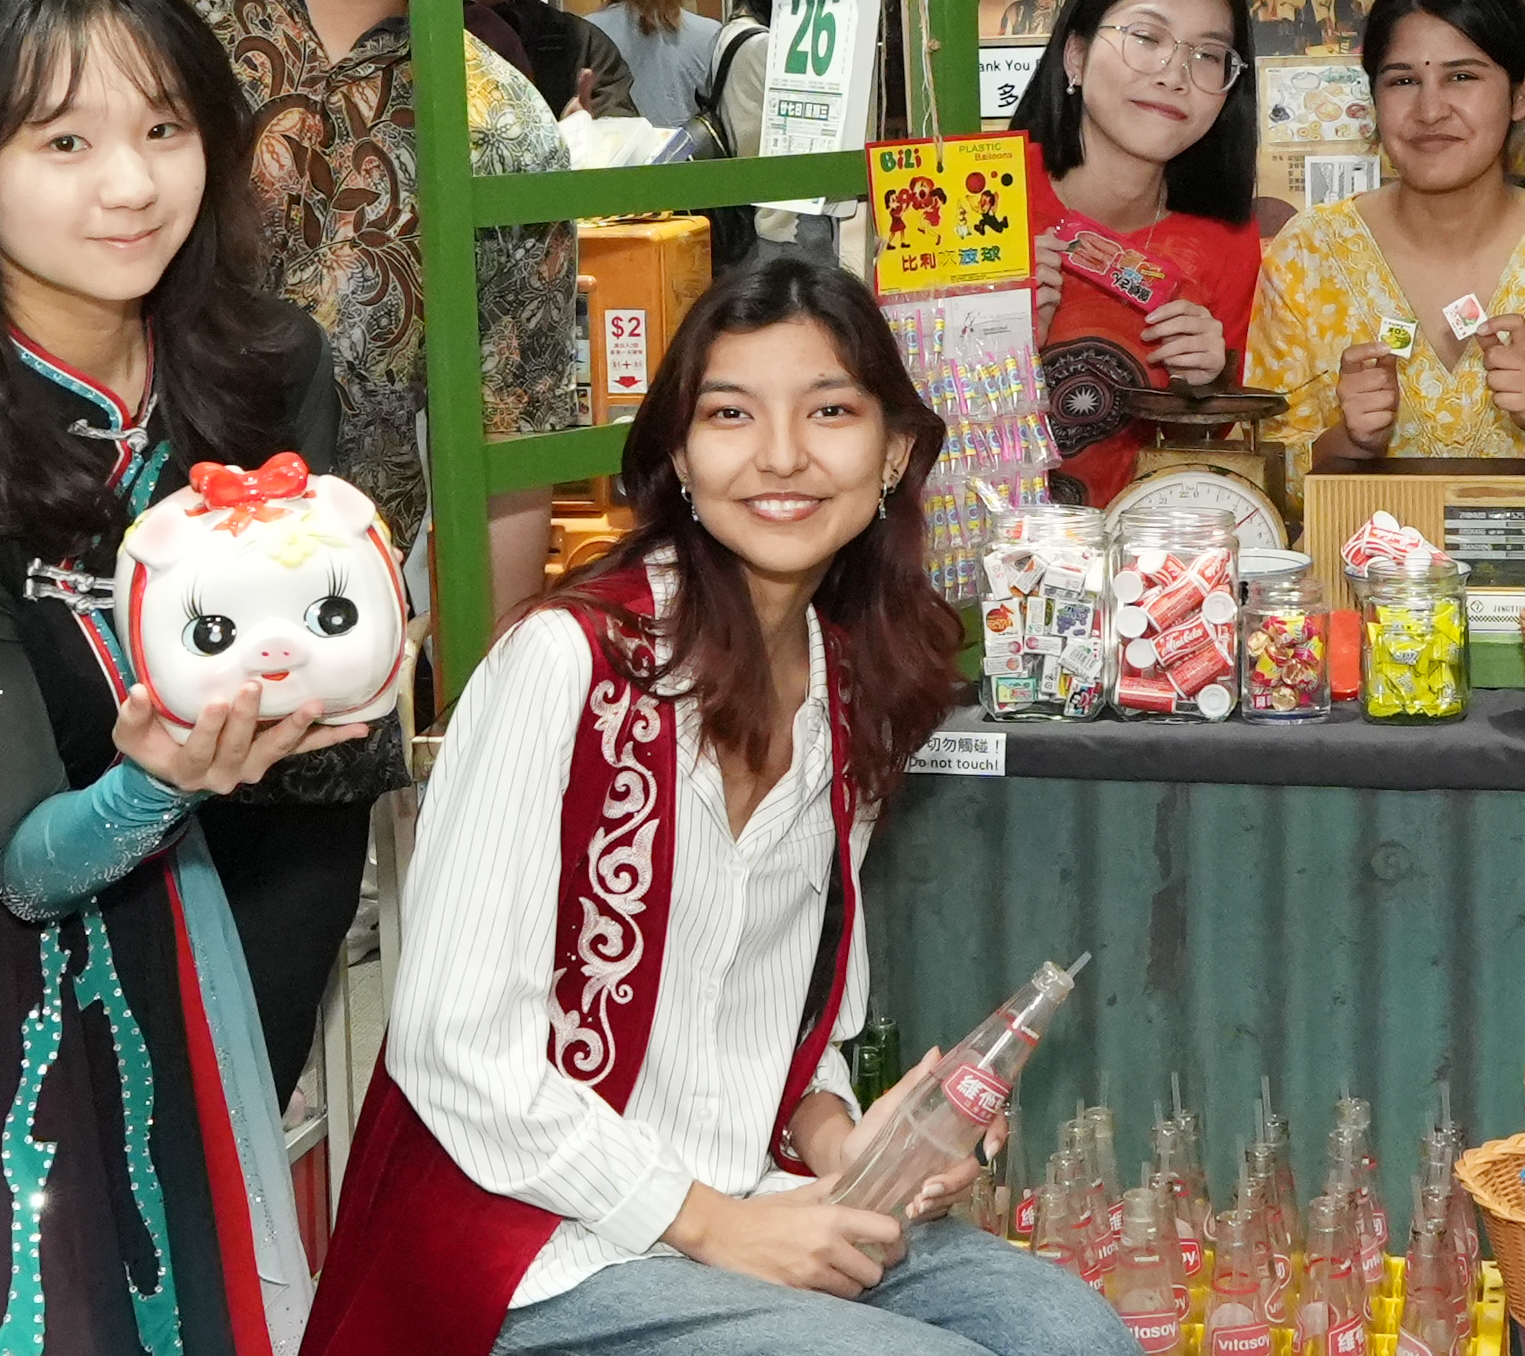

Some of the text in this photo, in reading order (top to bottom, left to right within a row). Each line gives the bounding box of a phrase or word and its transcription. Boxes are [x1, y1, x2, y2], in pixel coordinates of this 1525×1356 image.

[1005, 60, 1031, 73] You
[959, 143, 1002, 154] PLASTIC
[975, 152, 1013, 162] Balloons
[611, 316, 642, 340] $2
[930, 757, 952, 769] not
[957, 757, 999, 771] touch!
[1218, 1334, 1271, 1352] vitasoy
